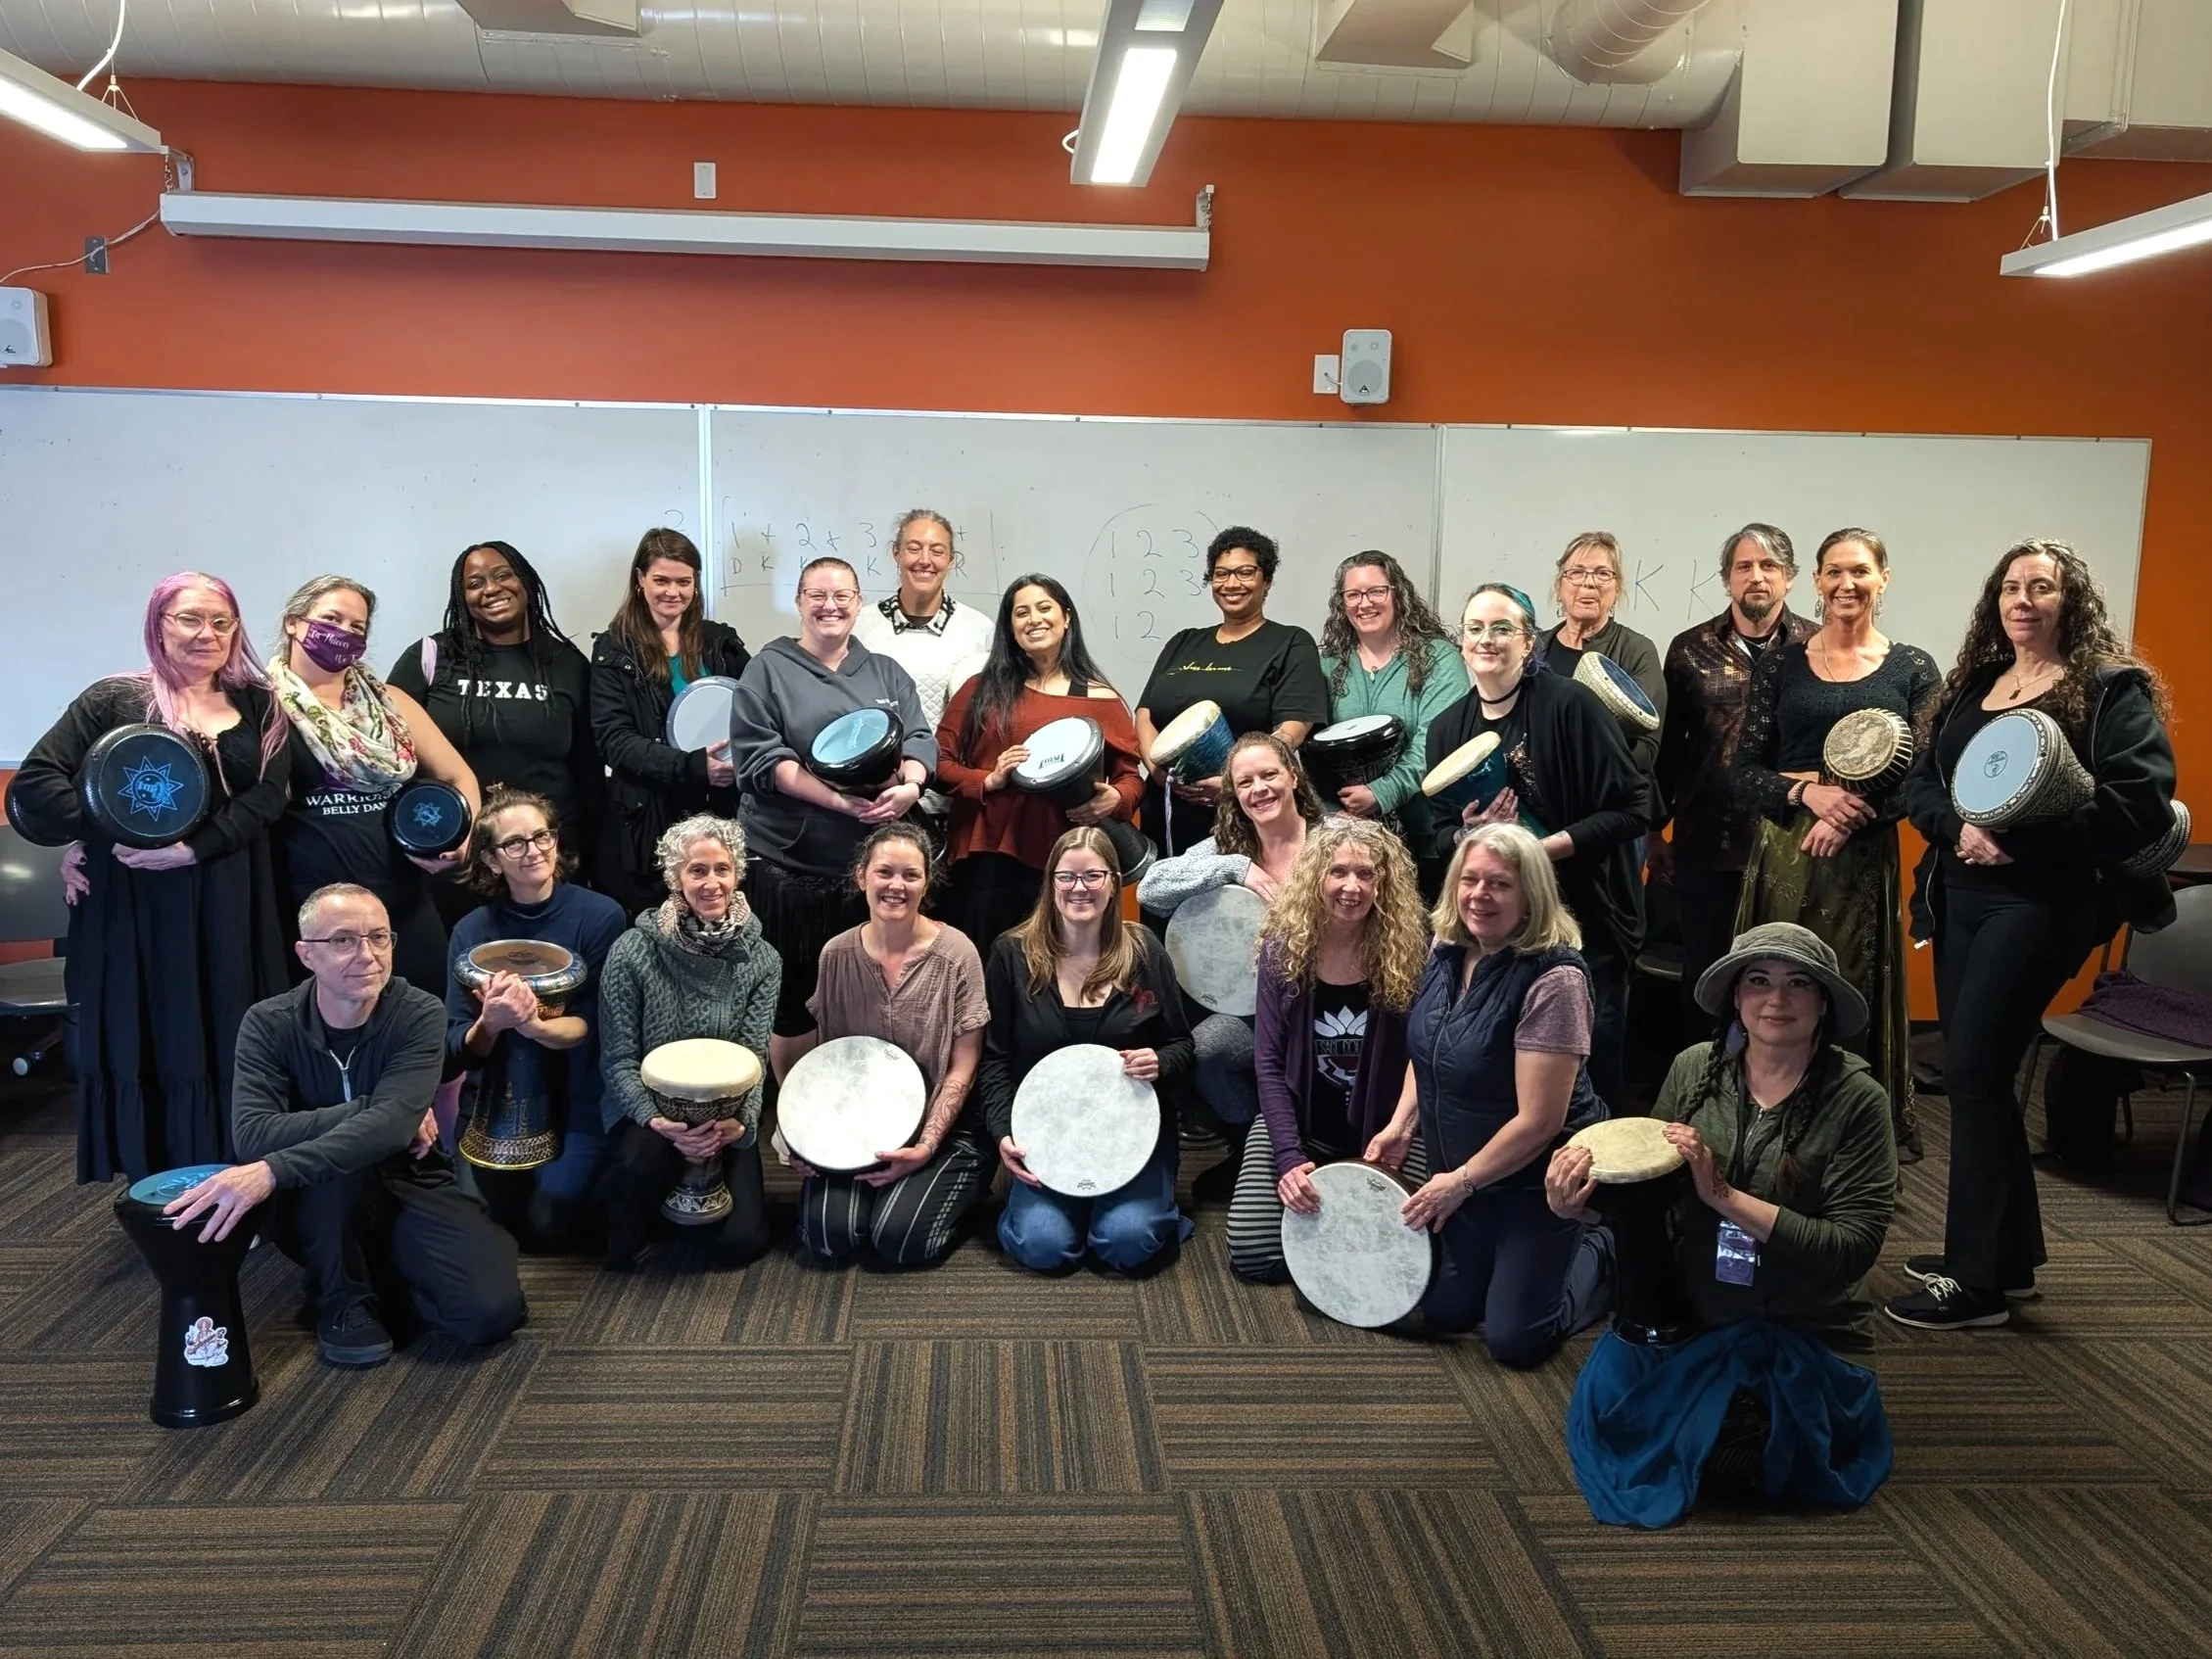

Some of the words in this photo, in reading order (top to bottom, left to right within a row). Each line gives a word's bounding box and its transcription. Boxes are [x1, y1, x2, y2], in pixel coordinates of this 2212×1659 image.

[795, 522, 818, 551] 2
[858, 522, 877, 548] 3
[1136, 529, 1163, 558] 2
[1172, 529, 1200, 558] 3
[729, 556, 743, 575] D
[761, 555, 775, 572] K
[867, 554, 881, 577] K
[1143, 568, 1166, 598] 2
[1179, 569, 1201, 596] 3
[1633, 558, 1665, 612] K
[1687, 557, 1717, 621] K
[1137, 610, 1161, 640] 2
[457, 679, 548, 701] TEXAS
[322, 803, 360, 816] BELLY
